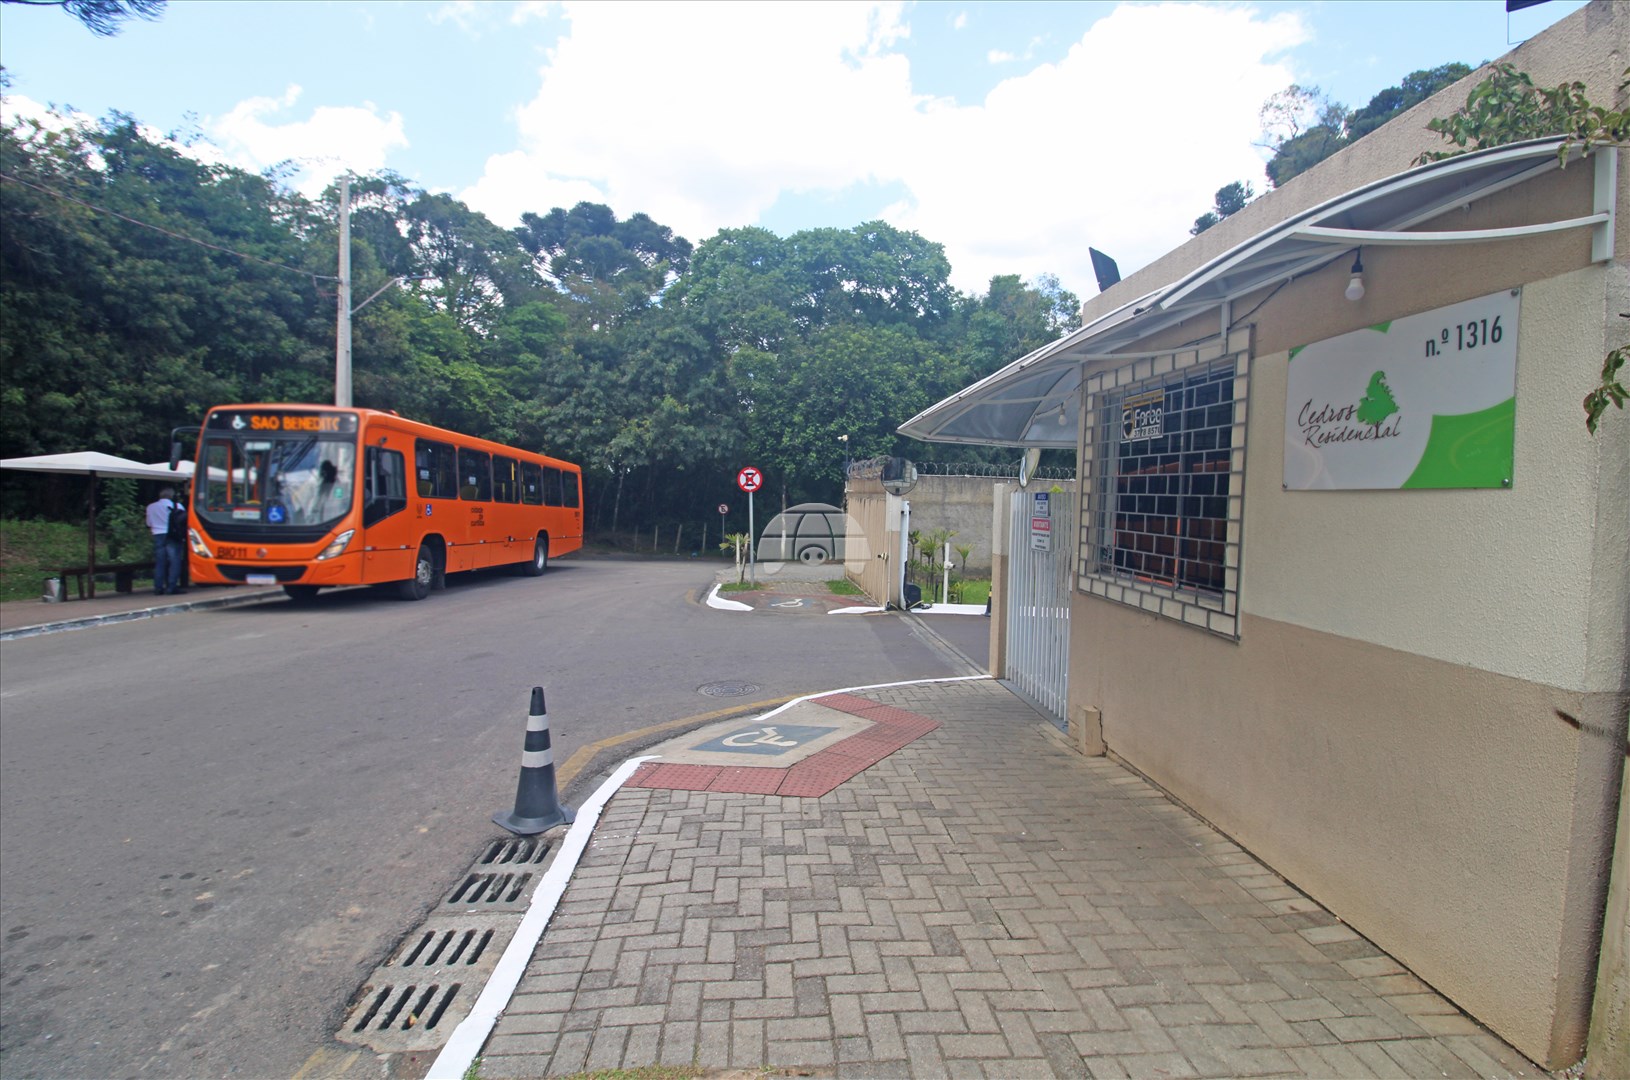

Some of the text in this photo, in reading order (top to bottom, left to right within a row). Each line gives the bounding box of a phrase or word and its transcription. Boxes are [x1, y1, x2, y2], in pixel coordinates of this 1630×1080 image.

[1456, 315, 1503, 351] 1316
[251, 415, 279, 430] SAO
[1134, 407, 1162, 428] Force
[1297, 398, 1359, 427] Cedros
[1302, 415, 1402, 448] Residencial
